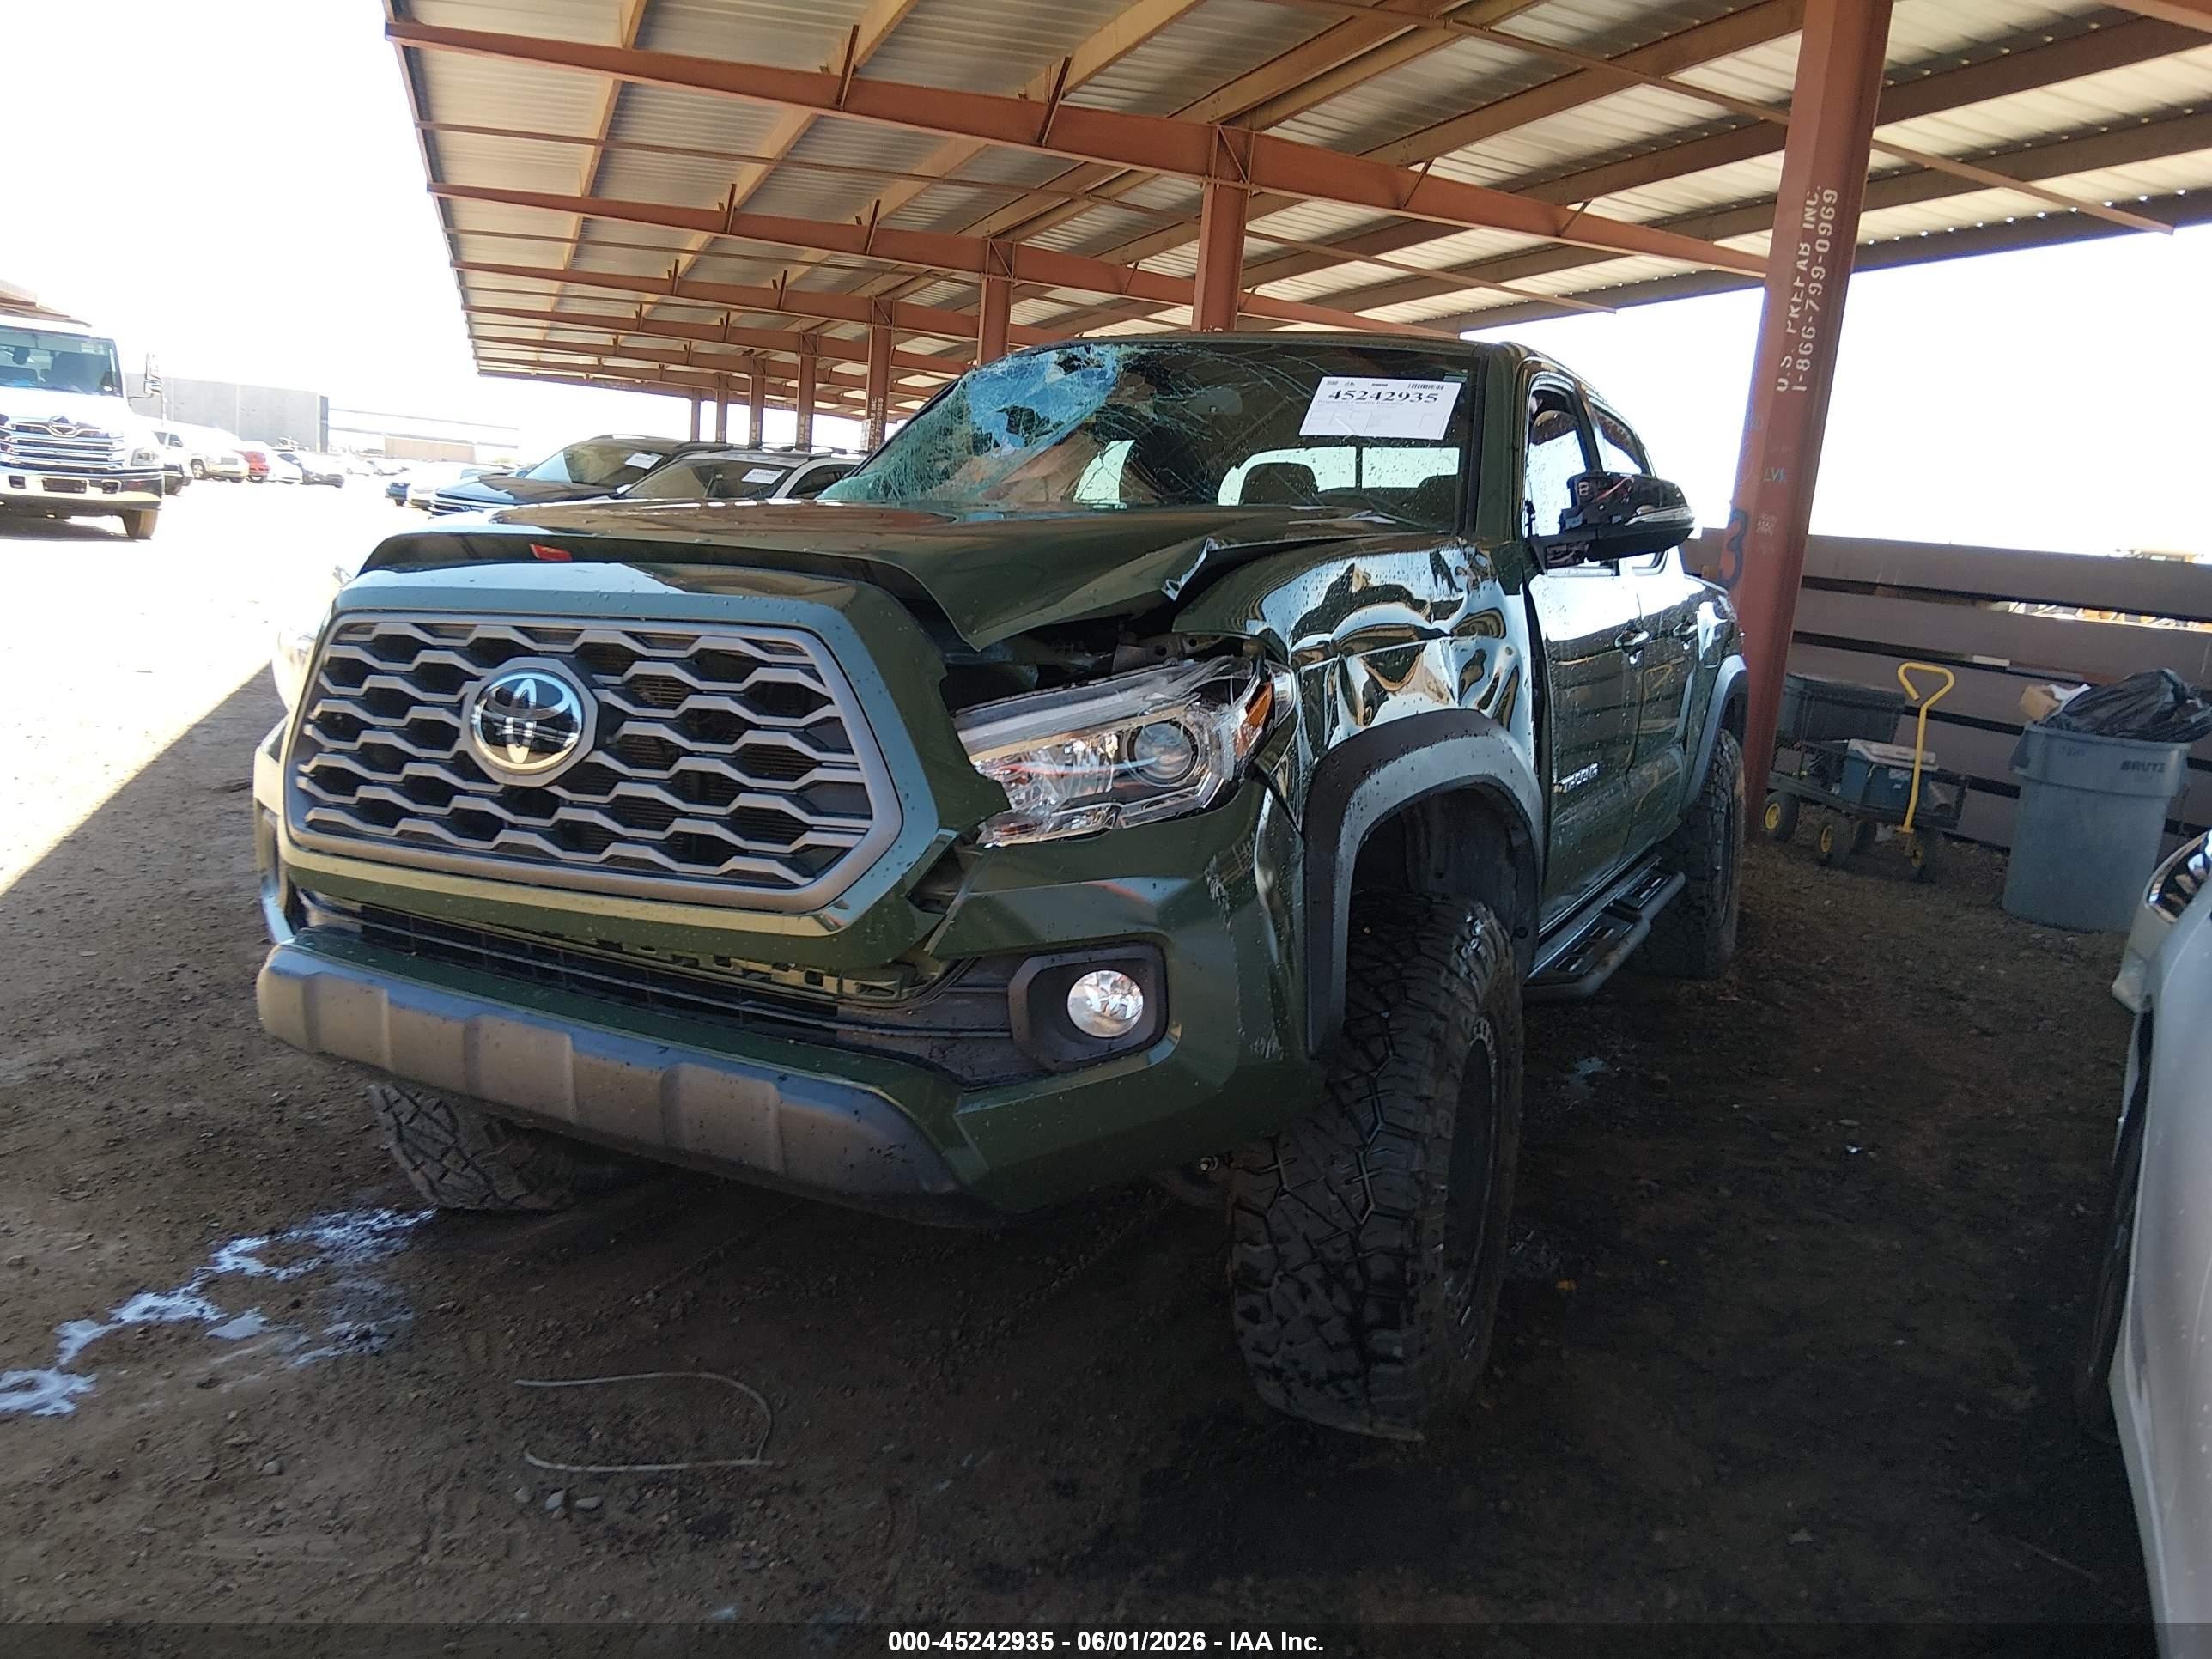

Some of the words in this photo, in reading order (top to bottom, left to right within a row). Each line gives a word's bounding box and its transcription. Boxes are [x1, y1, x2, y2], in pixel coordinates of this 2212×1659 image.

[1786, 242, 1811, 334] PREFAB
[1802, 185, 1822, 229] INC.
[1792, 188, 1838, 392] 1-866-799-0969
[1328, 388, 1439, 404] 45242935
